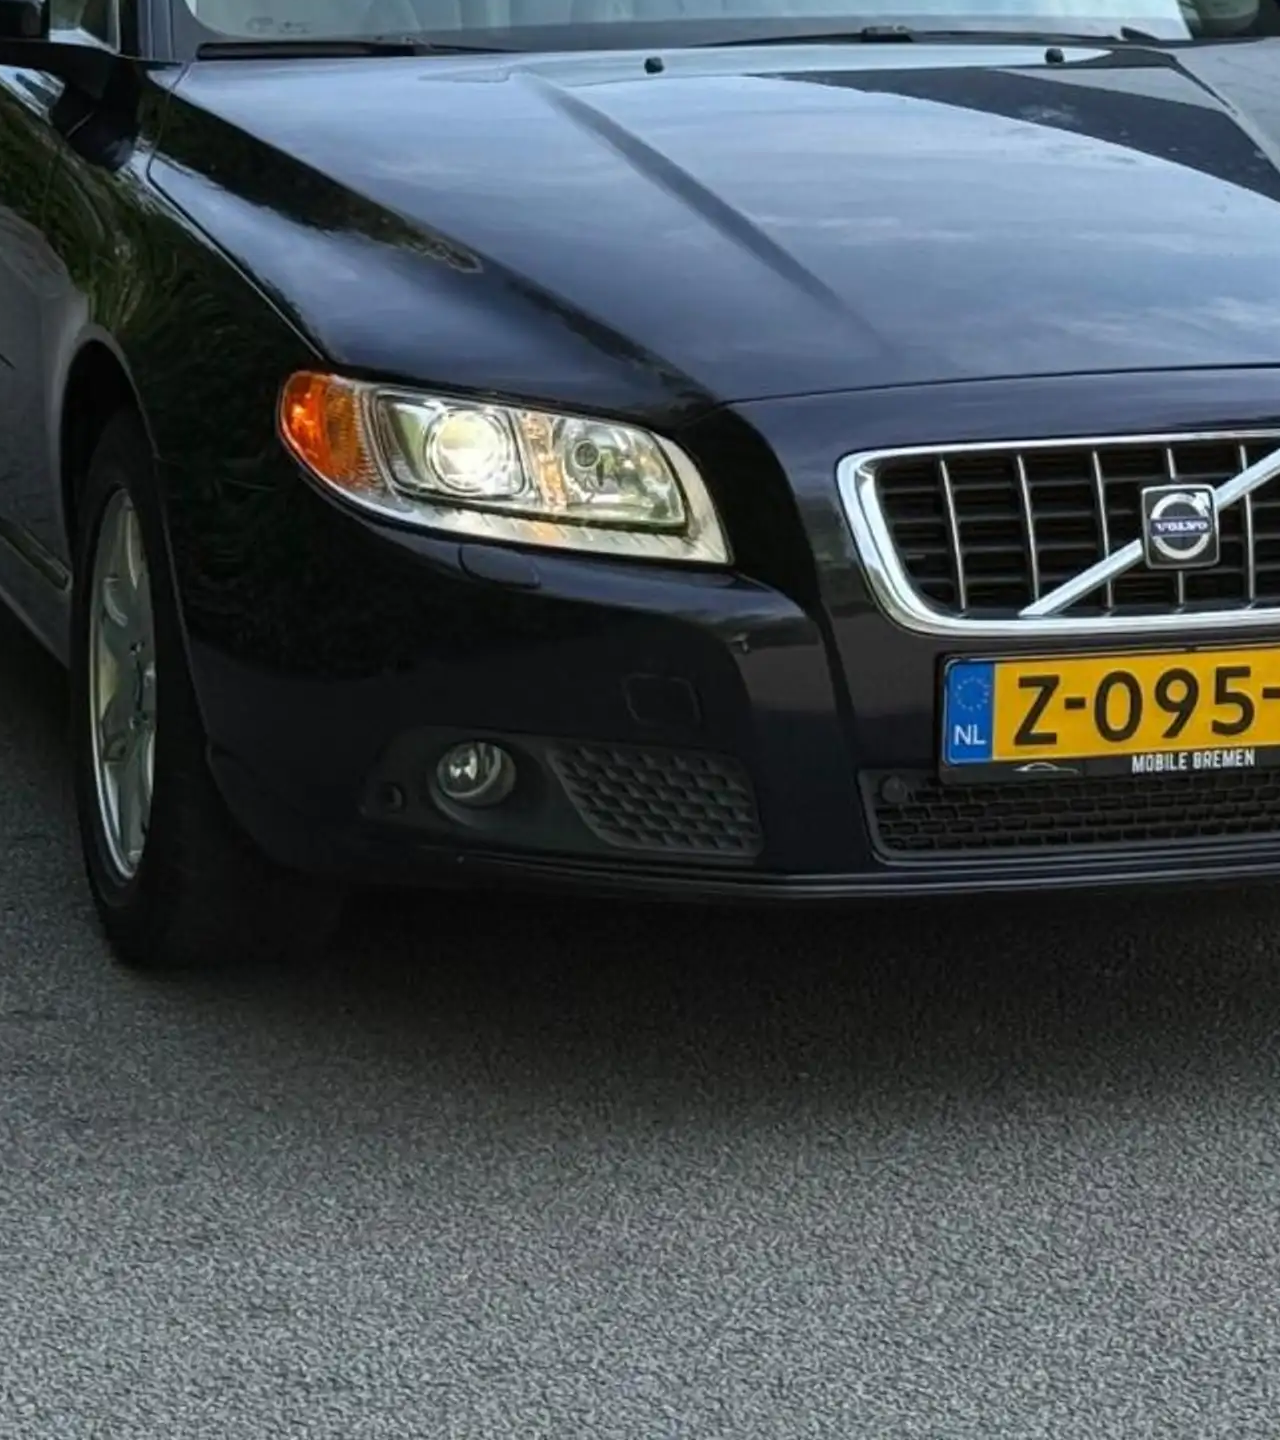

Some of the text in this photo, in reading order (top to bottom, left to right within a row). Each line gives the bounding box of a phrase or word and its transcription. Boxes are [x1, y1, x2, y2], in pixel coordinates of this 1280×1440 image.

[1154, 521, 1208, 532] VOLVO
[954, 724, 986, 746] NL
[1131, 747, 1255, 773] MOBILE BREMEN
